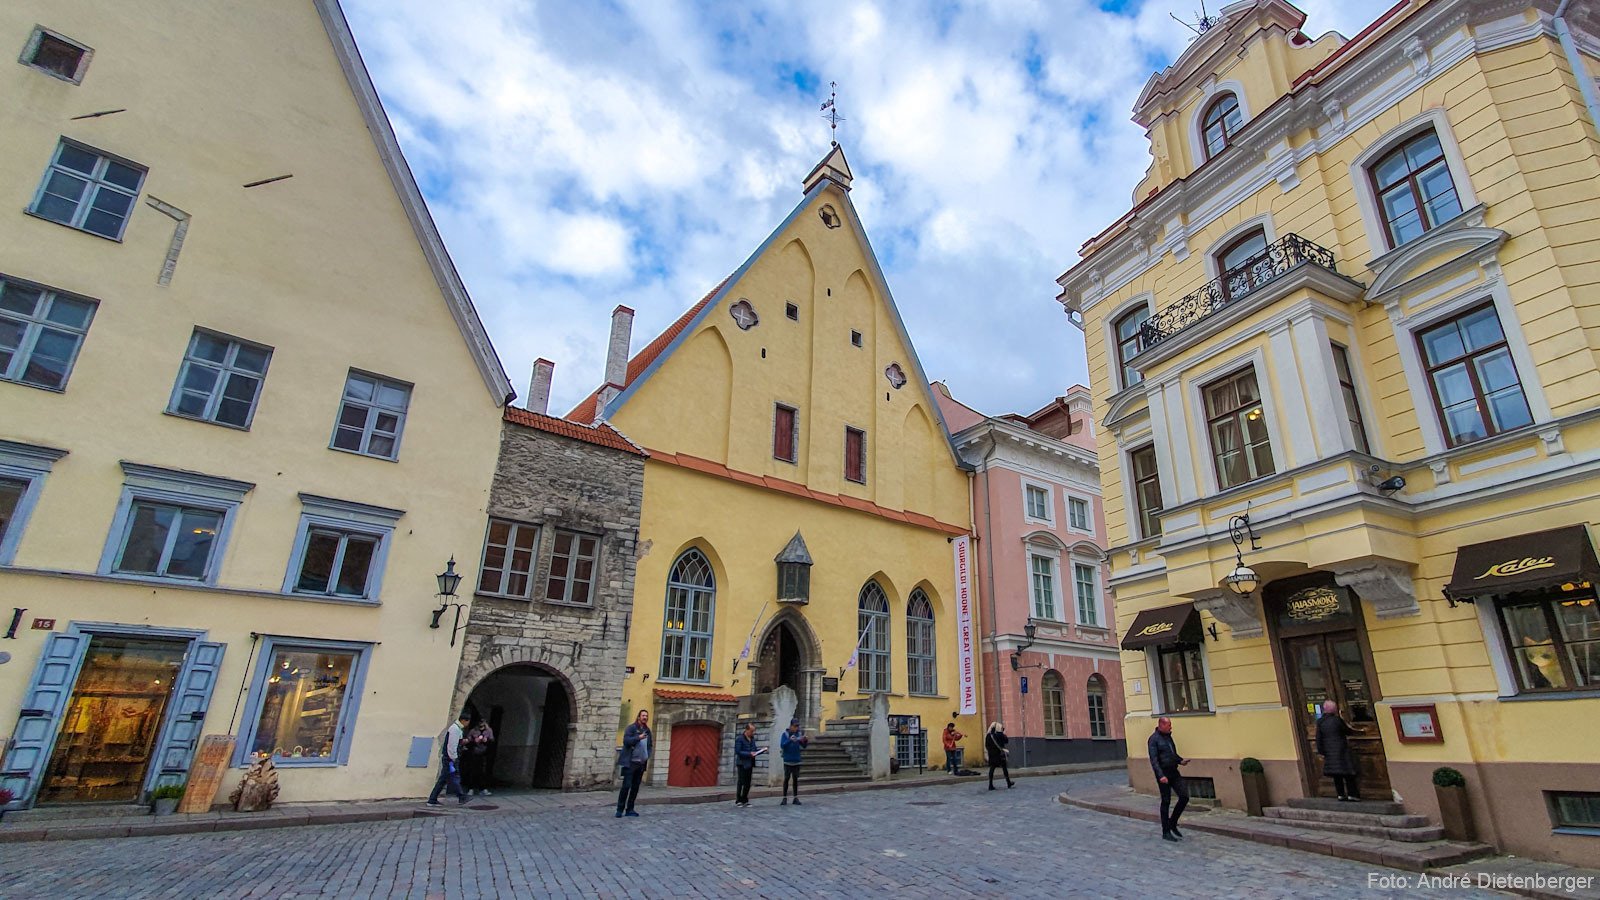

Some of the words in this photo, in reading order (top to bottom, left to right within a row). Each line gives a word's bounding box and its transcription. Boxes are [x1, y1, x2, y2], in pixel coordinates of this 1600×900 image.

[958, 541, 967, 584] SUURGILDI
[1473, 556, 1555, 580] Kalev
[1286, 595, 1338, 610] MAIASMOKK
[962, 626, 970, 652] GREAT
[1135, 622, 1174, 637] Kalev
[963, 657, 972, 683] GUILD
[964, 686, 972, 709] HALL
